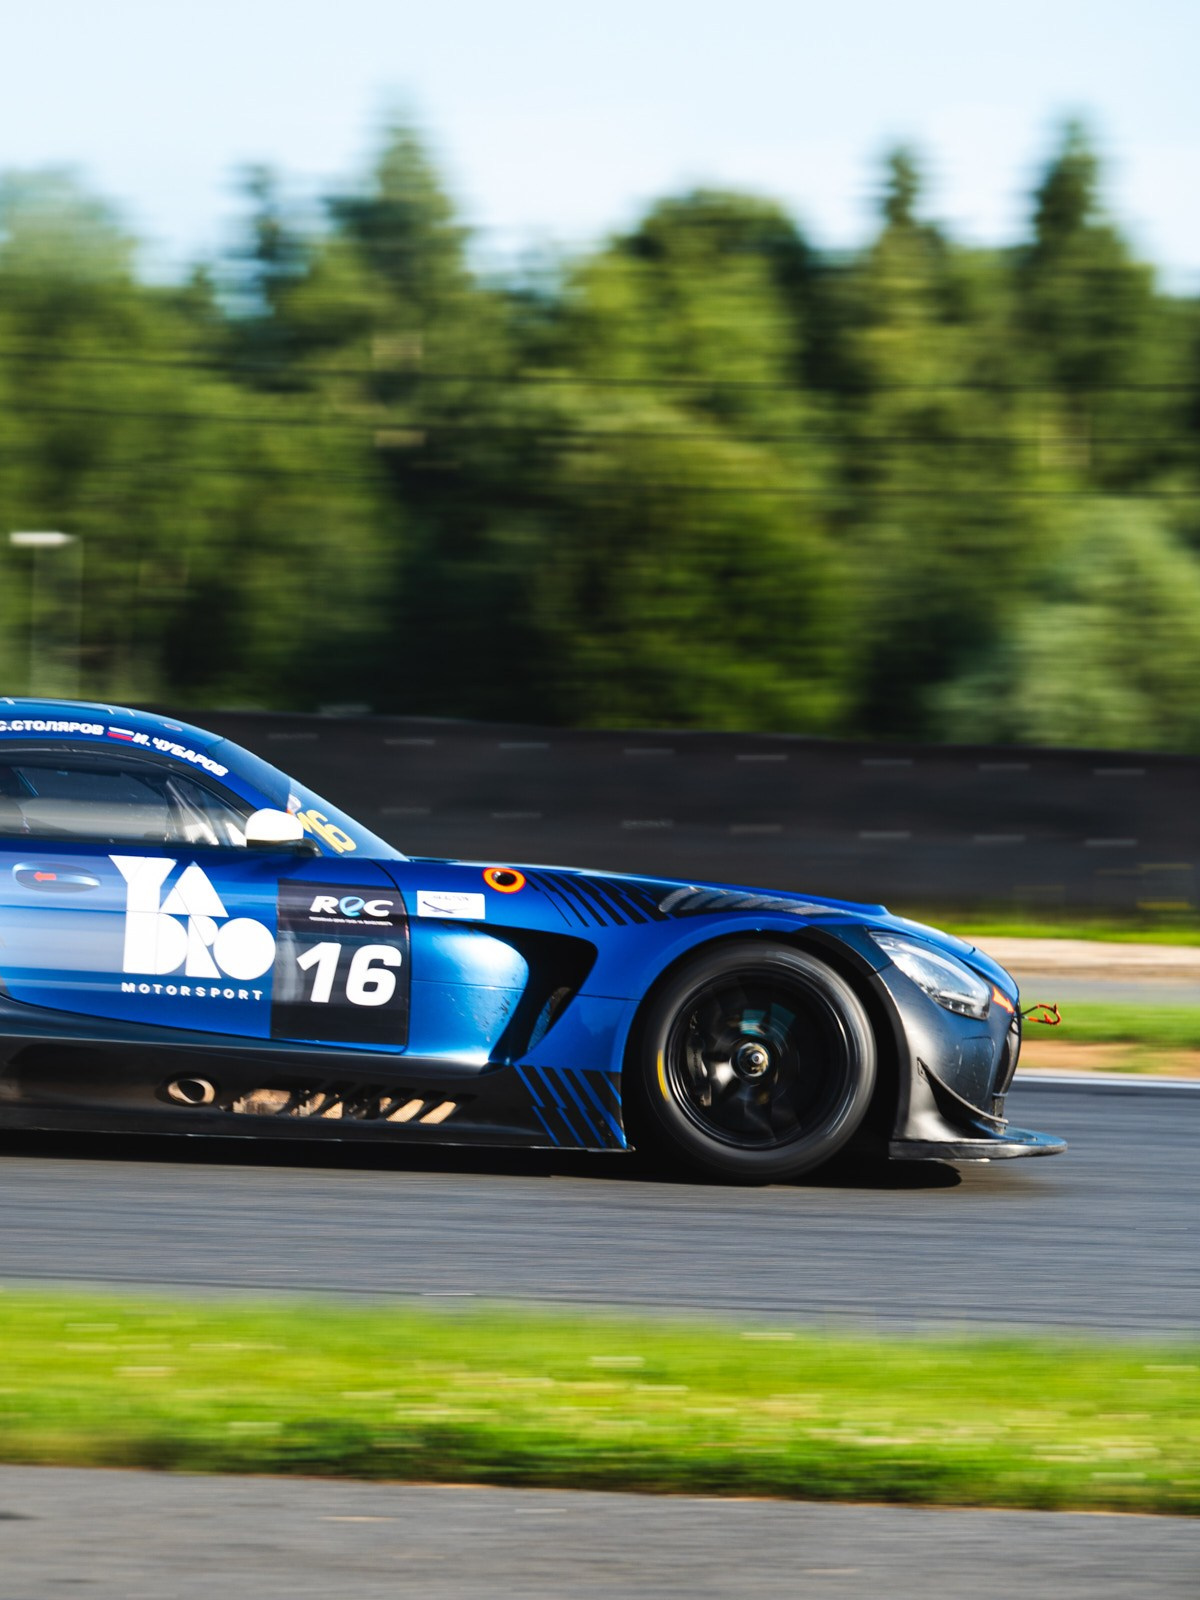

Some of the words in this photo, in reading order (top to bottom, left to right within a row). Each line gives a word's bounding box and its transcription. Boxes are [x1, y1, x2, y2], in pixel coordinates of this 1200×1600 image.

[297, 809, 357, 853] 16
[121, 982, 263, 1001] MOTORSPORT
[296, 942, 403, 1007] 16
